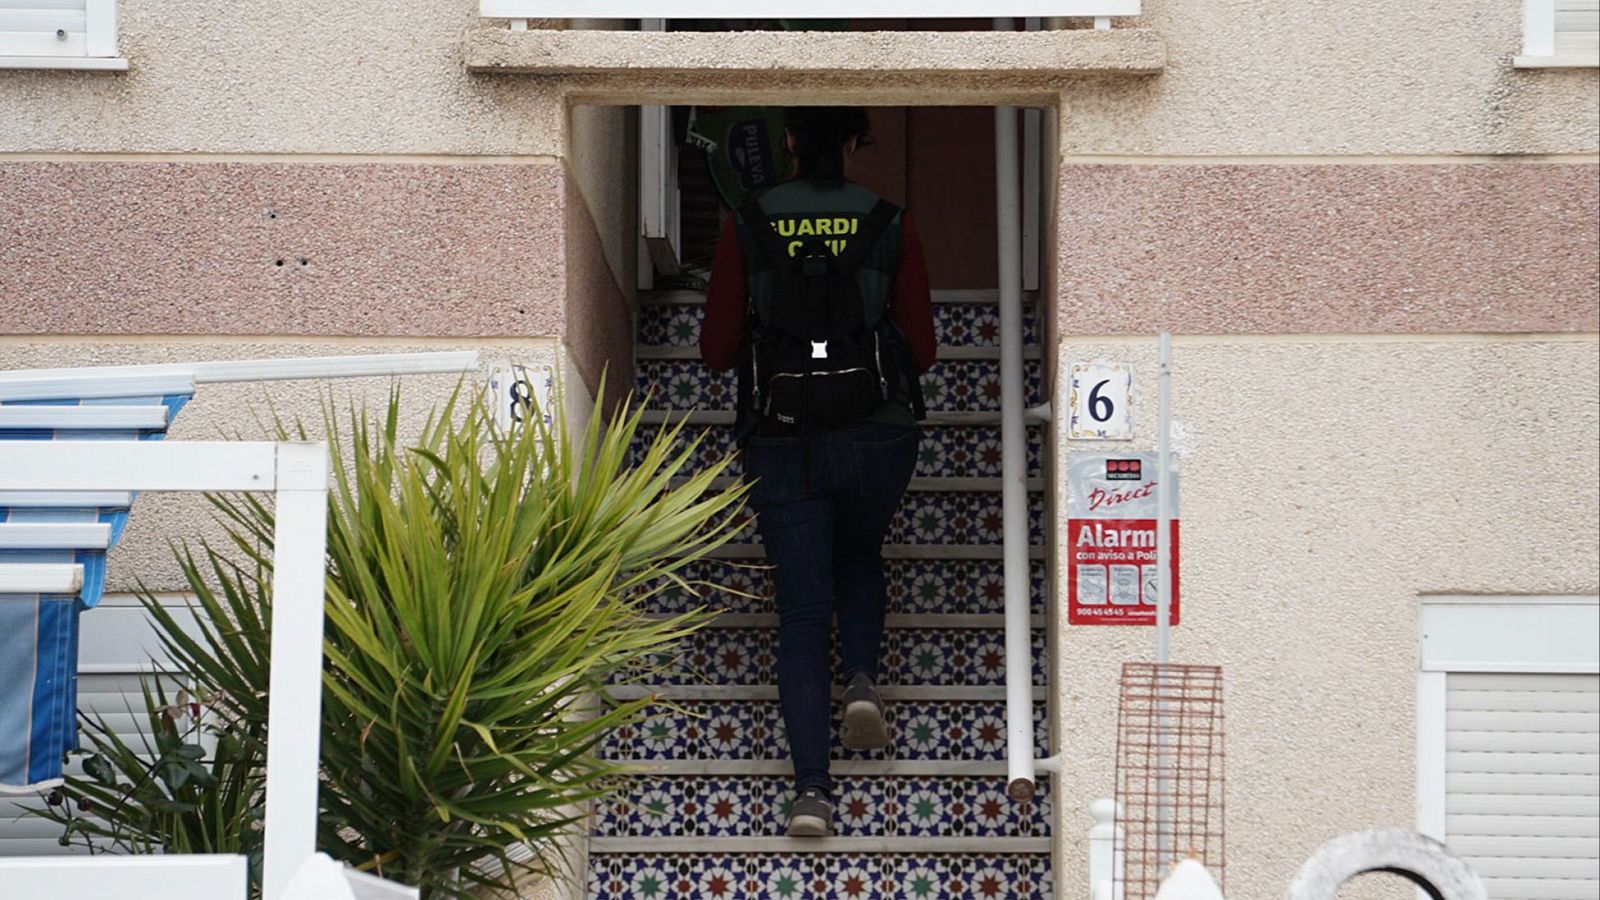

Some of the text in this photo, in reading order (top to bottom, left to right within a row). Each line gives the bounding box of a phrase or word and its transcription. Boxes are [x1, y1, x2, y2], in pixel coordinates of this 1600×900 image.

[743, 123, 766, 185] PULEVA
[770, 217, 858, 237] UARDI
[510, 380, 535, 422] 8
[1088, 379, 1114, 423] 6
[1088, 481, 1158, 511] Direct
[1076, 523, 1156, 548] Alarm
[1076, 551, 1095, 560] con
[1097, 549, 1125, 560] aviso
[1127, 551, 1134, 560] a
